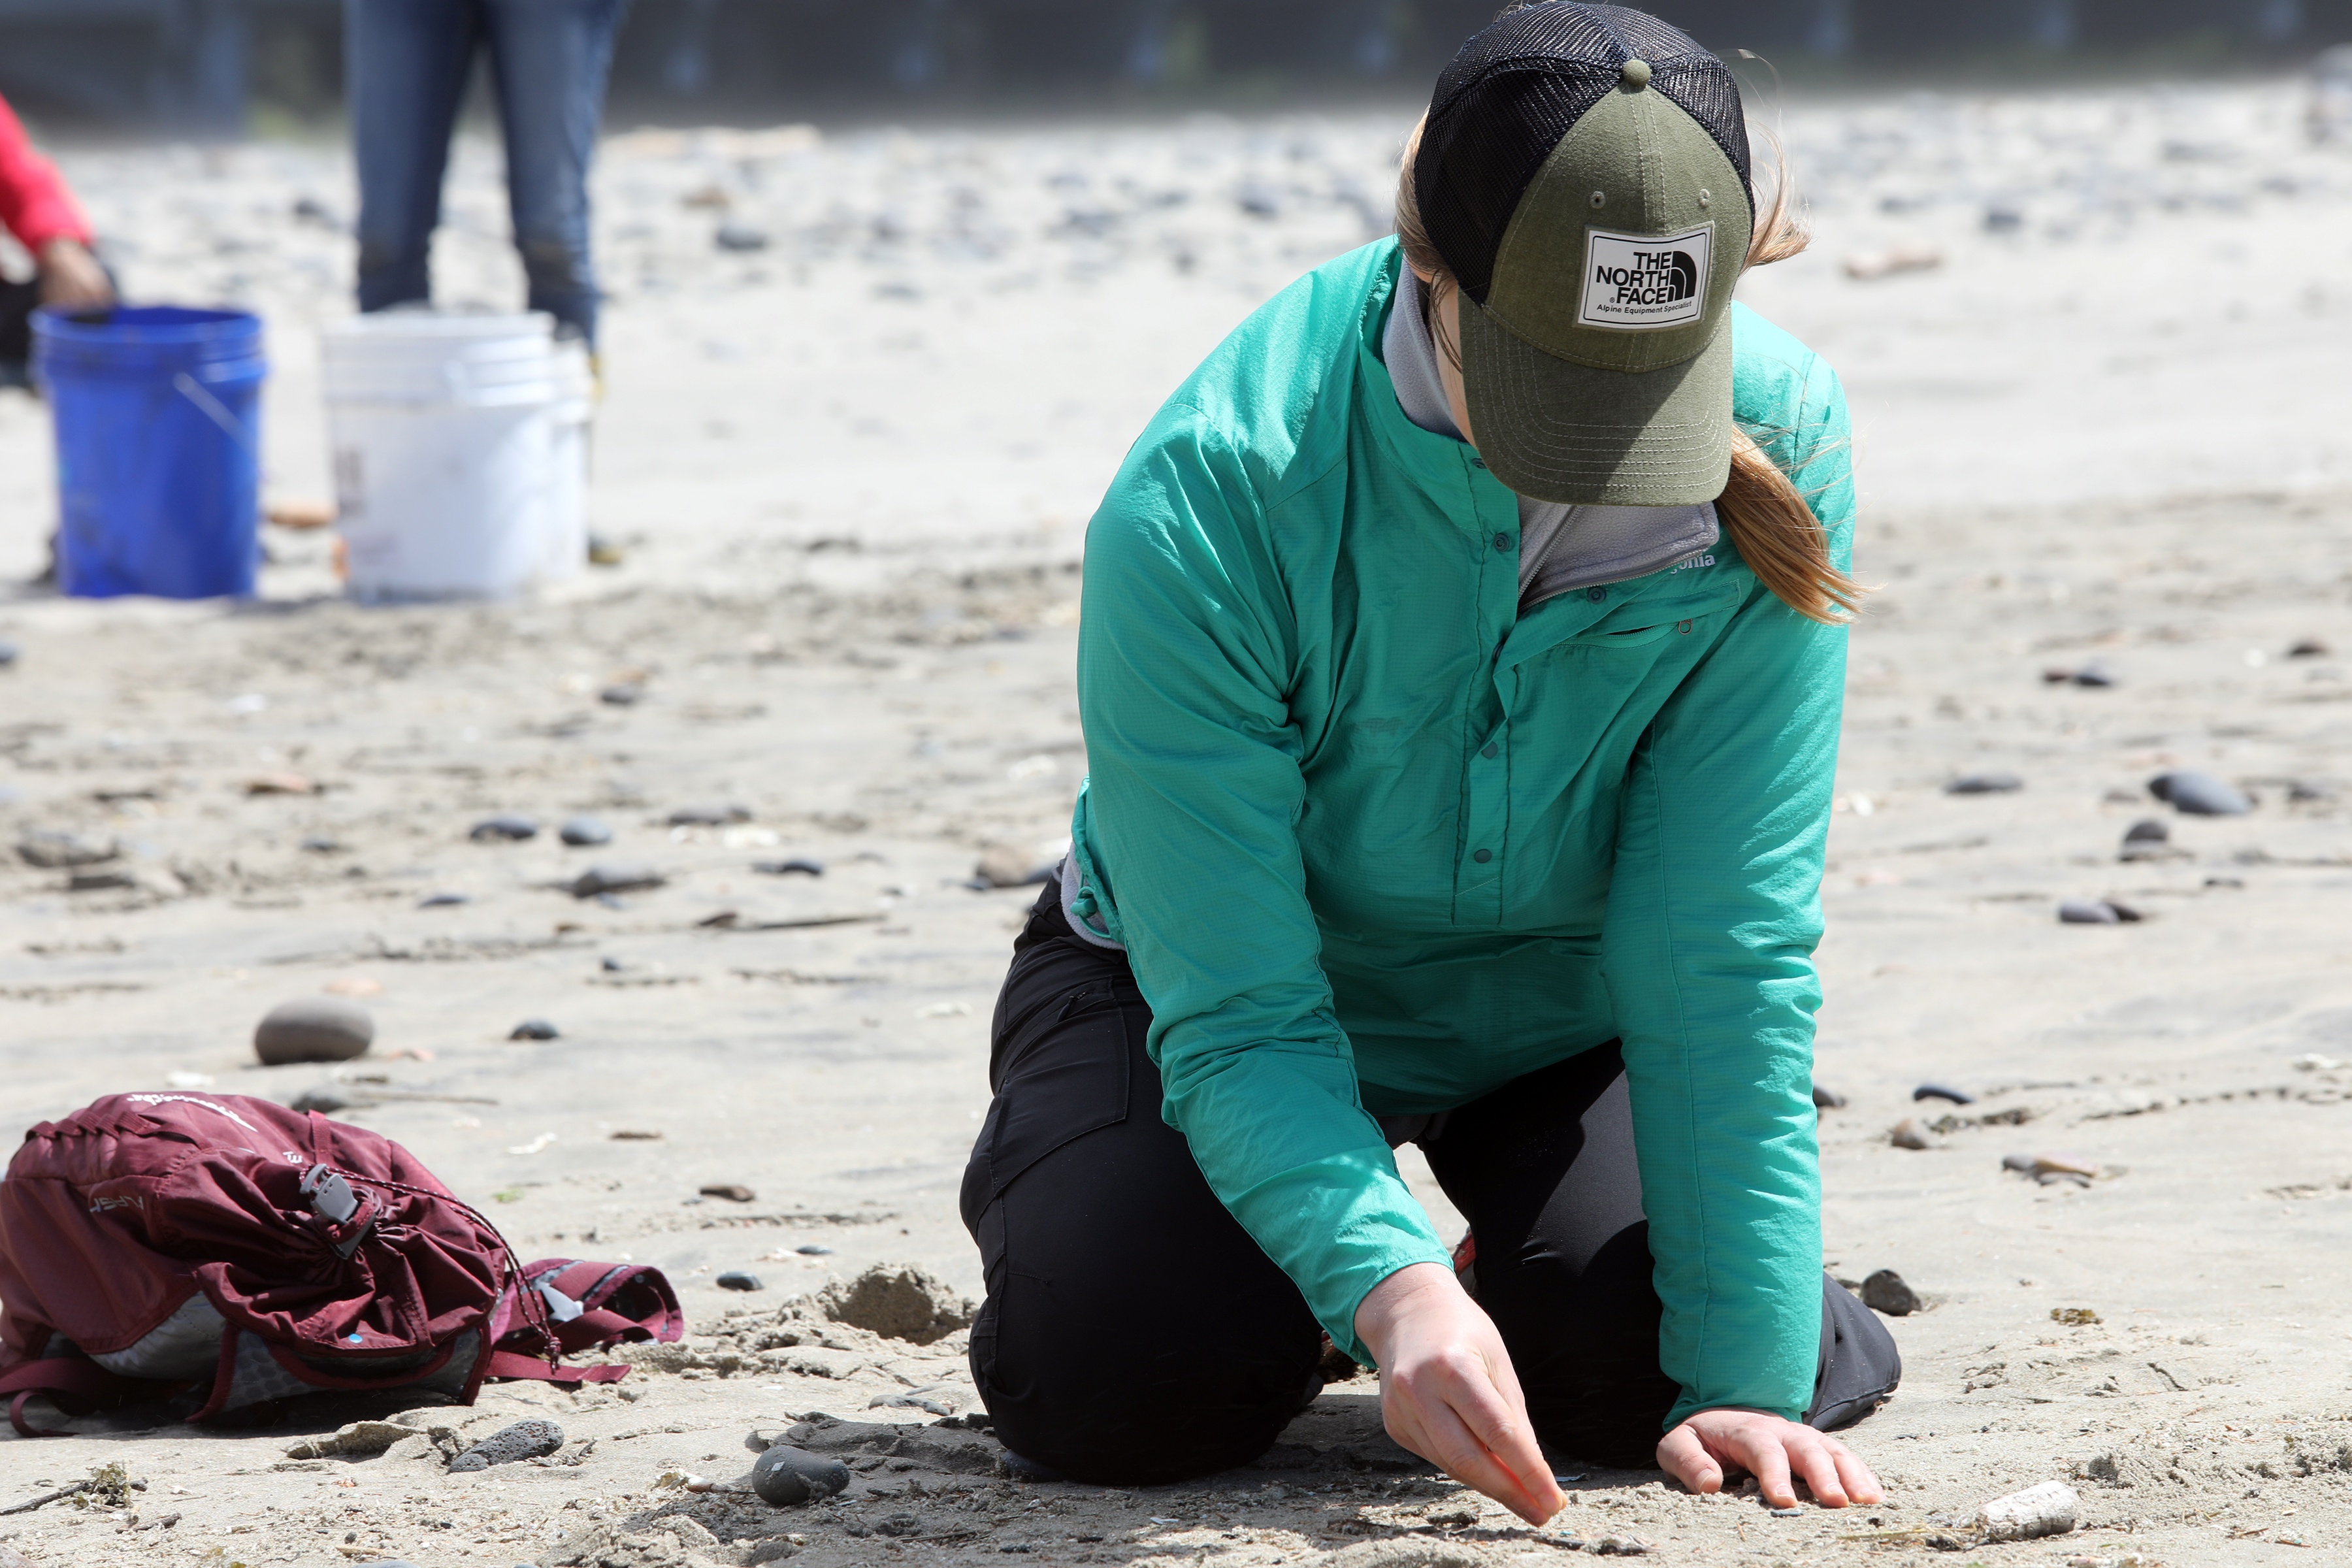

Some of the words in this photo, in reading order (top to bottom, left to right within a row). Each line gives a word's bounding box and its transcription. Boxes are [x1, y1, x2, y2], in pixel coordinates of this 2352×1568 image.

[1633, 251, 1672, 270] THE
[1596, 265, 1670, 287] NORTH
[1616, 286, 1668, 305] FACE
[1597, 304, 1622, 313] Alpine
[1624, 306, 1663, 315] Equipment
[1664, 301, 1692, 312] Specialist
